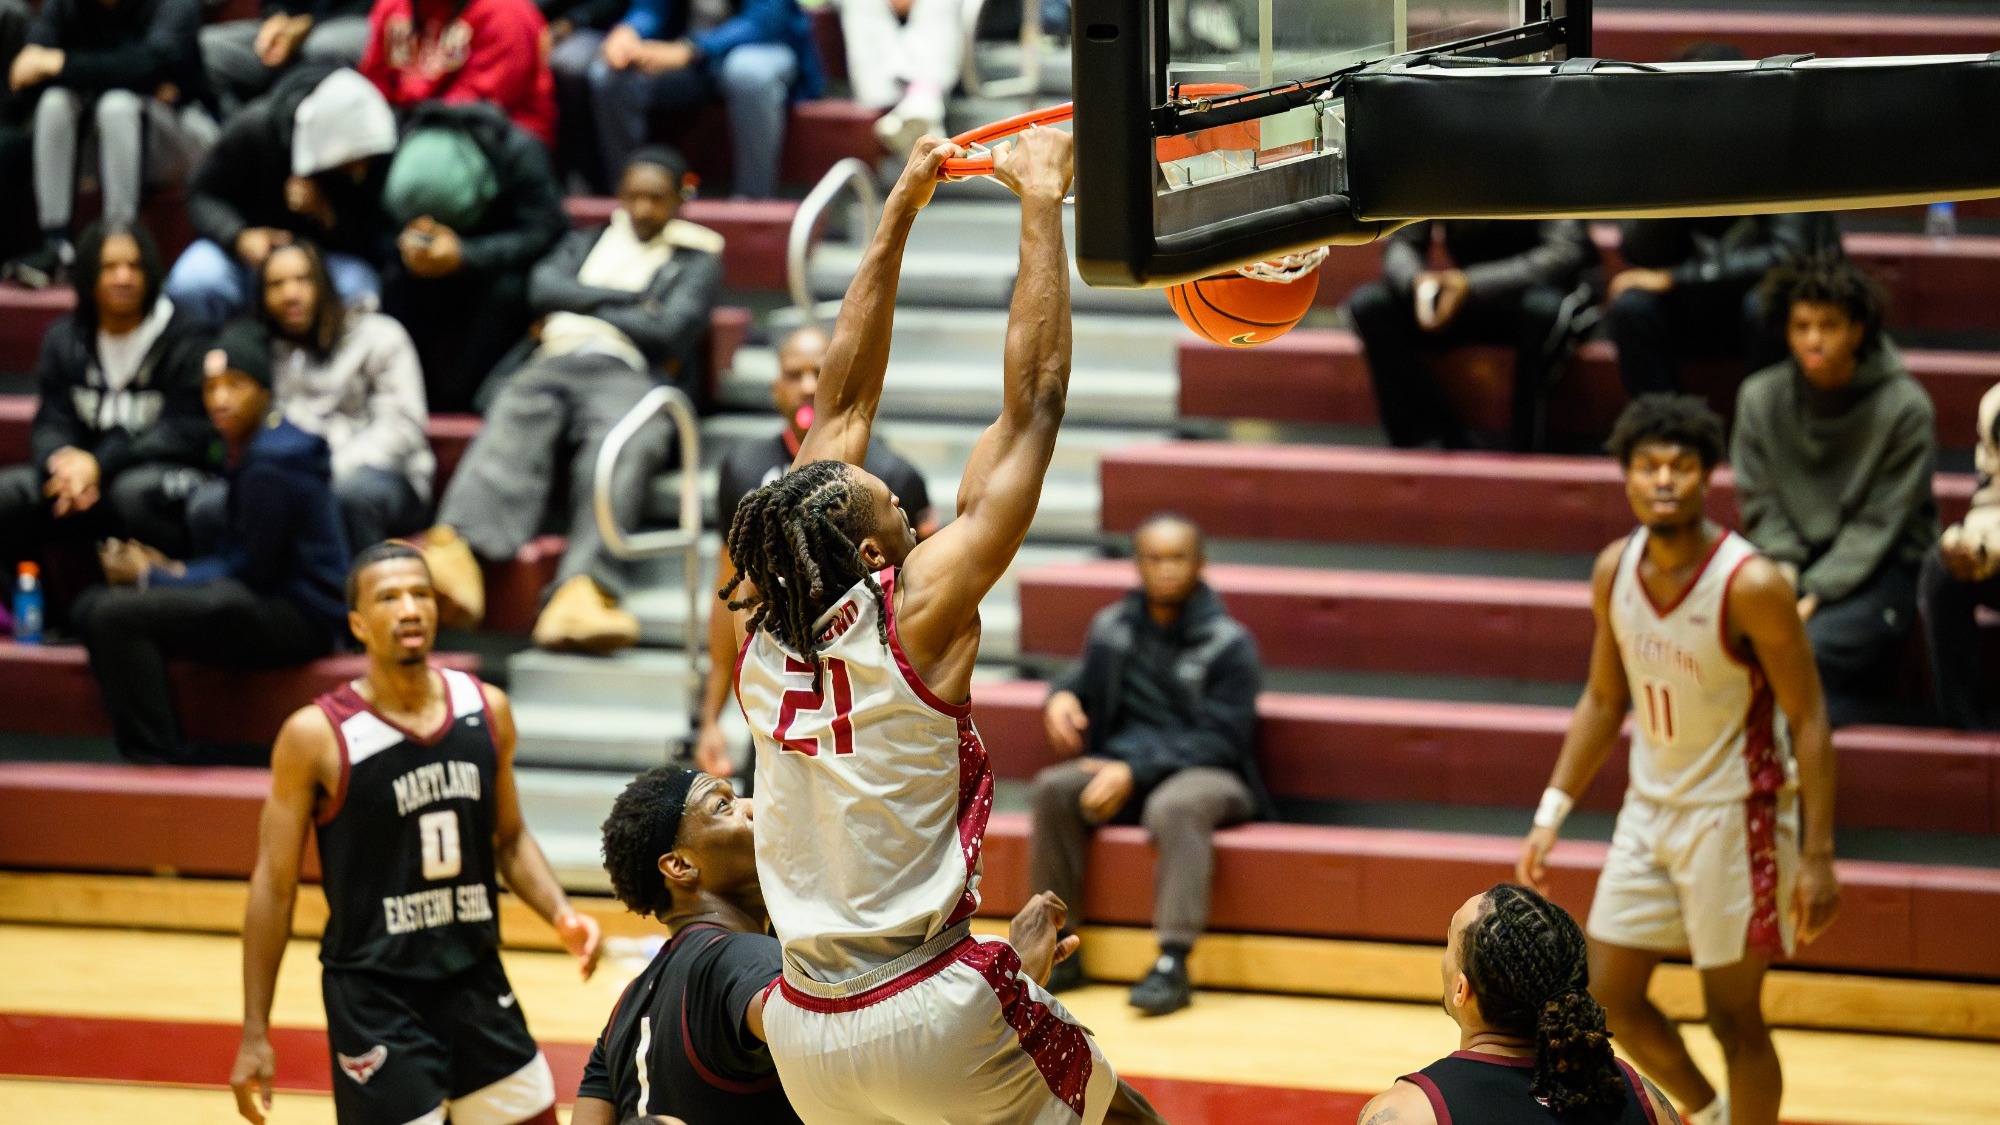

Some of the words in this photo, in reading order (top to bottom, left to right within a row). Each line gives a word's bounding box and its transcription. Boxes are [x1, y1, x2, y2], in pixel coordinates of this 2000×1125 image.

[773, 655, 856, 760] 21
[1643, 680, 1676, 742] 11
[392, 760, 481, 816] MARYLAND
[419, 810, 462, 881] 0
[382, 886, 454, 935] EASTERN
[635, 1016, 651, 1118] 1
